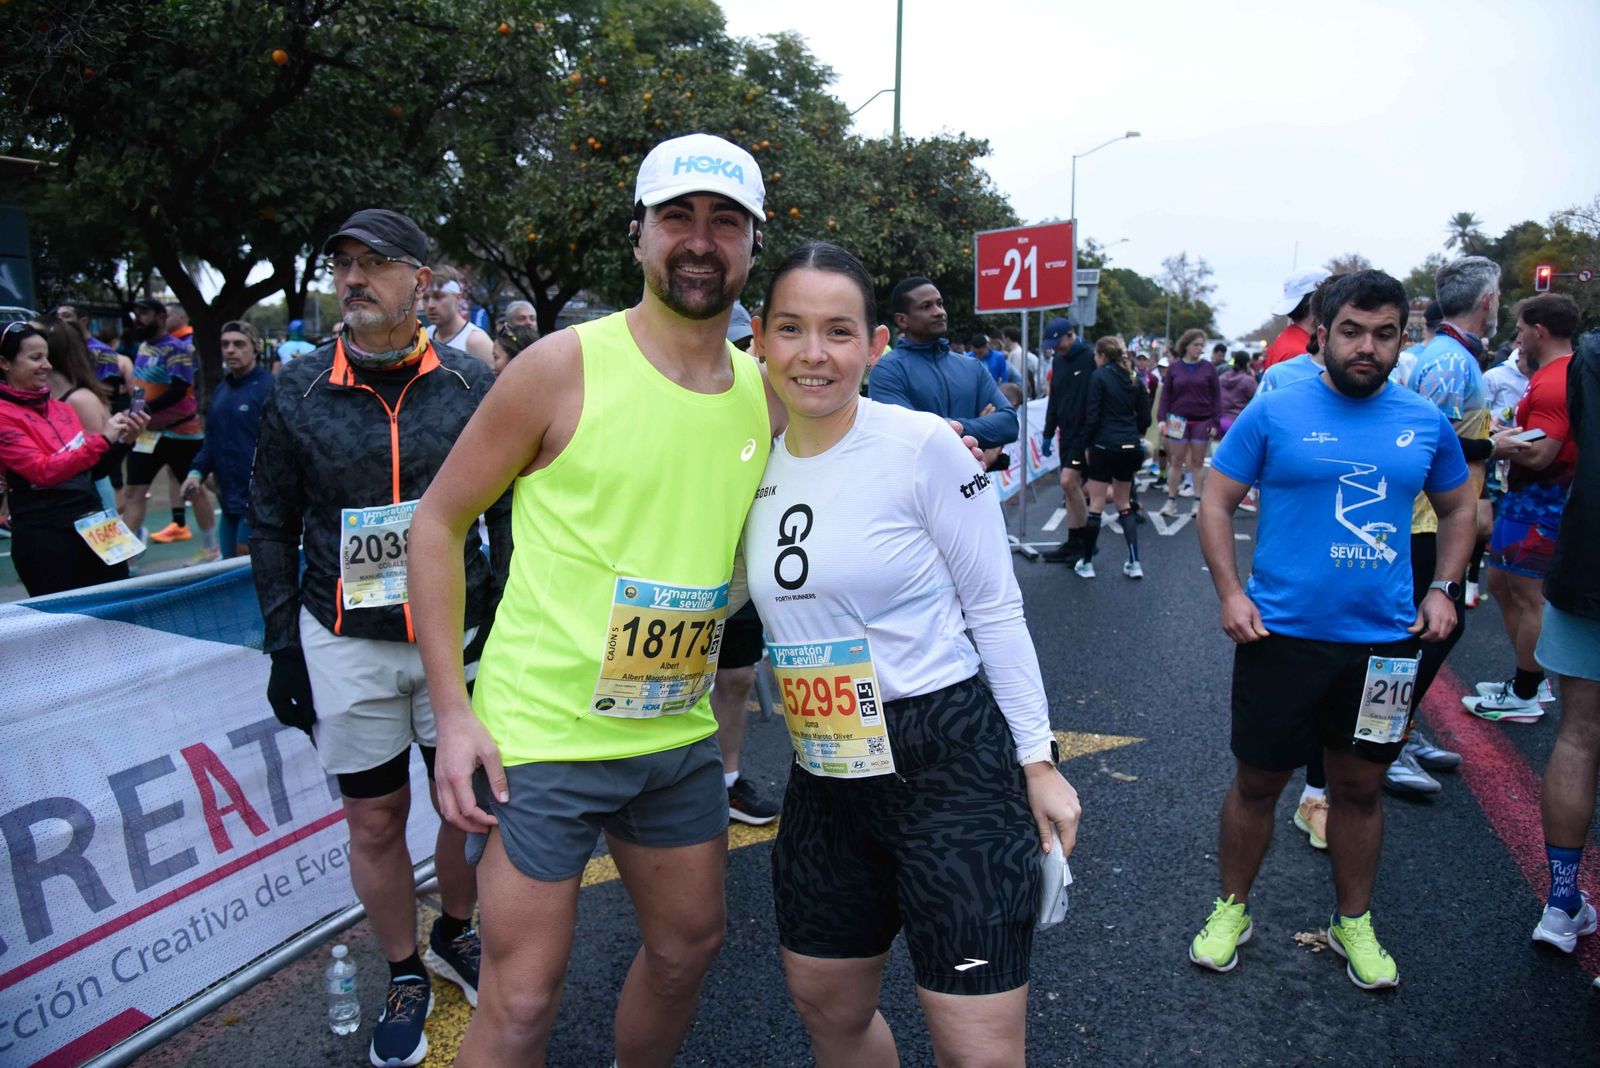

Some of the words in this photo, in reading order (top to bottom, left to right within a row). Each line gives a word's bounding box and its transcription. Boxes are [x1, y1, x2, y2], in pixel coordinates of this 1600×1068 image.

[673, 156, 744, 184] HOKA
[1003, 246, 1037, 300] 21
[774, 503, 813, 590] GO
[1330, 546, 1383, 560] SEVILLA
[668, 588, 713, 600] maratón
[678, 599, 711, 608] sevilla
[607, 634, 618, 660] CAJÓN
[622, 616, 716, 659] 18173
[782, 645, 823, 656] maratón
[660, 662, 680, 670] Albert
[792, 654, 823, 665] sevilla
[782, 675, 857, 717] 5295
[1370, 679, 1413, 705] 210
[642, 703, 660, 711] HOKA
[0, 716, 344, 950] REAT
[111, 897, 249, 984] Creativa
[255, 873, 293, 908] de
